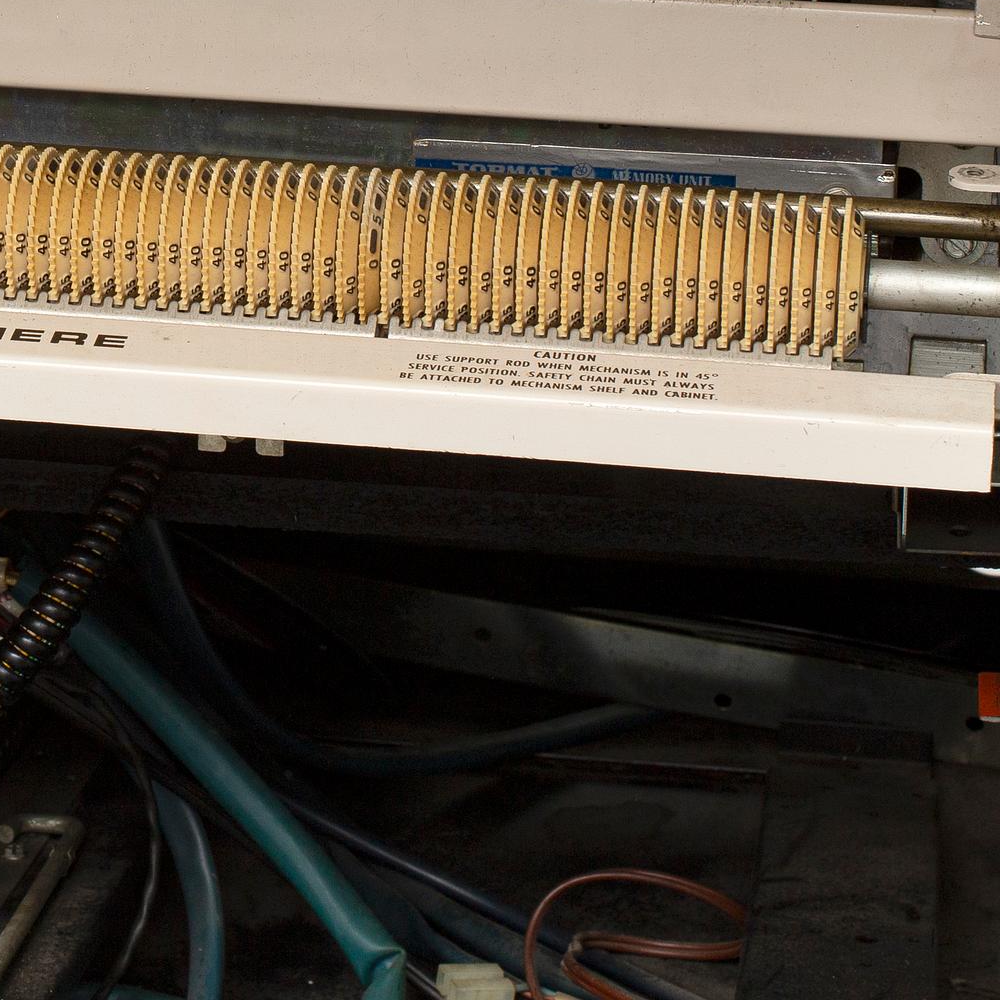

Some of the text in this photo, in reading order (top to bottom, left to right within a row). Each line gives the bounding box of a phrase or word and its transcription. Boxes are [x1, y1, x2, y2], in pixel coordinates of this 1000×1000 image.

[37, 234, 48, 255] 40
[190, 246, 201, 267] 40
[301, 252, 311, 273] 40
[435, 261, 446, 283] 40
[503, 265, 513, 287] 40
[571, 271, 582, 292] 40
[640, 282, 650, 303] 40
[709, 280, 719, 301] 40
[779, 286, 789, 308] 40
[849, 291, 858, 312] 40
[416, 353, 439, 362] USE
[444, 355, 499, 366] SUPPORT
[505, 359, 531, 368] ROD
[537, 361, 573, 371] WHEN
[578, 364, 651, 376] MECHANISM
[657, 370, 669, 378] IS
[675, 371, 689, 379] IN
[533, 350, 597, 362] CAUTION
[399, 371, 415, 380] BE
[419, 373, 482, 384] ATTACHED
[488, 377, 504, 386] TO
[510, 379, 583, 391] MECHANISM
[589, 385, 626, 394] SHELF
[631, 388, 658, 396] AND
[408, 362, 456, 373] SERVICE
[528, 370, 573, 381] SAFETY
[579, 374, 617, 384] CHAIN
[622, 377, 657, 387] MUST
[663, 380, 715, 391] ALWAYS
